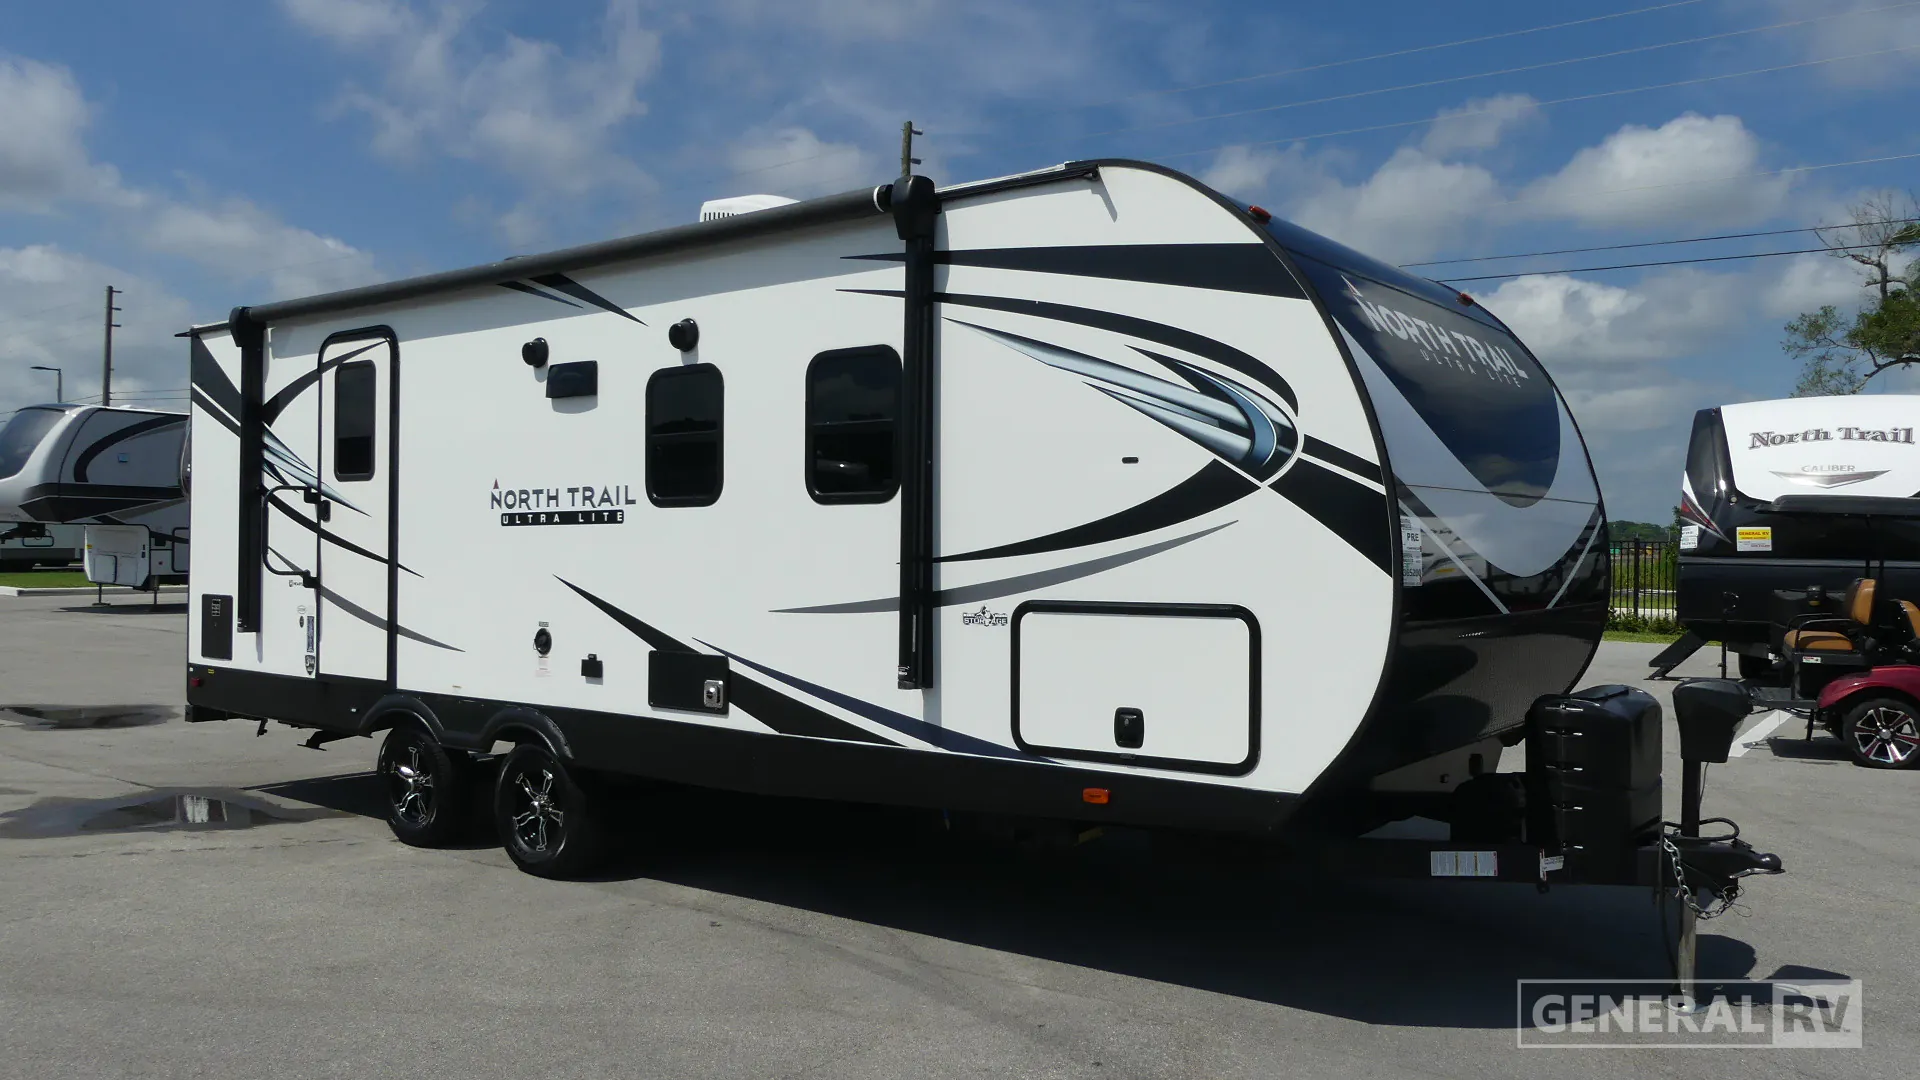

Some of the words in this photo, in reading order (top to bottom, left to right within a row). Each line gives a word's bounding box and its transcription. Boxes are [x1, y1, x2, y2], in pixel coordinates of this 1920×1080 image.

[1352, 295, 1461, 358] NORTH
[1451, 330, 1529, 380] TRAIL
[1420, 349, 1477, 375] ULTRA
[1487, 370, 1521, 388] LITE
[1748, 428, 1834, 451] North
[1836, 426, 1916, 446] Trail
[1800, 464, 1856, 473] CALIBER
[490, 487, 560, 511] NORTH
[566, 484, 637, 509] TRAIL
[502, 513, 561, 525] ULTRA
[578, 511, 624, 523] LITE
